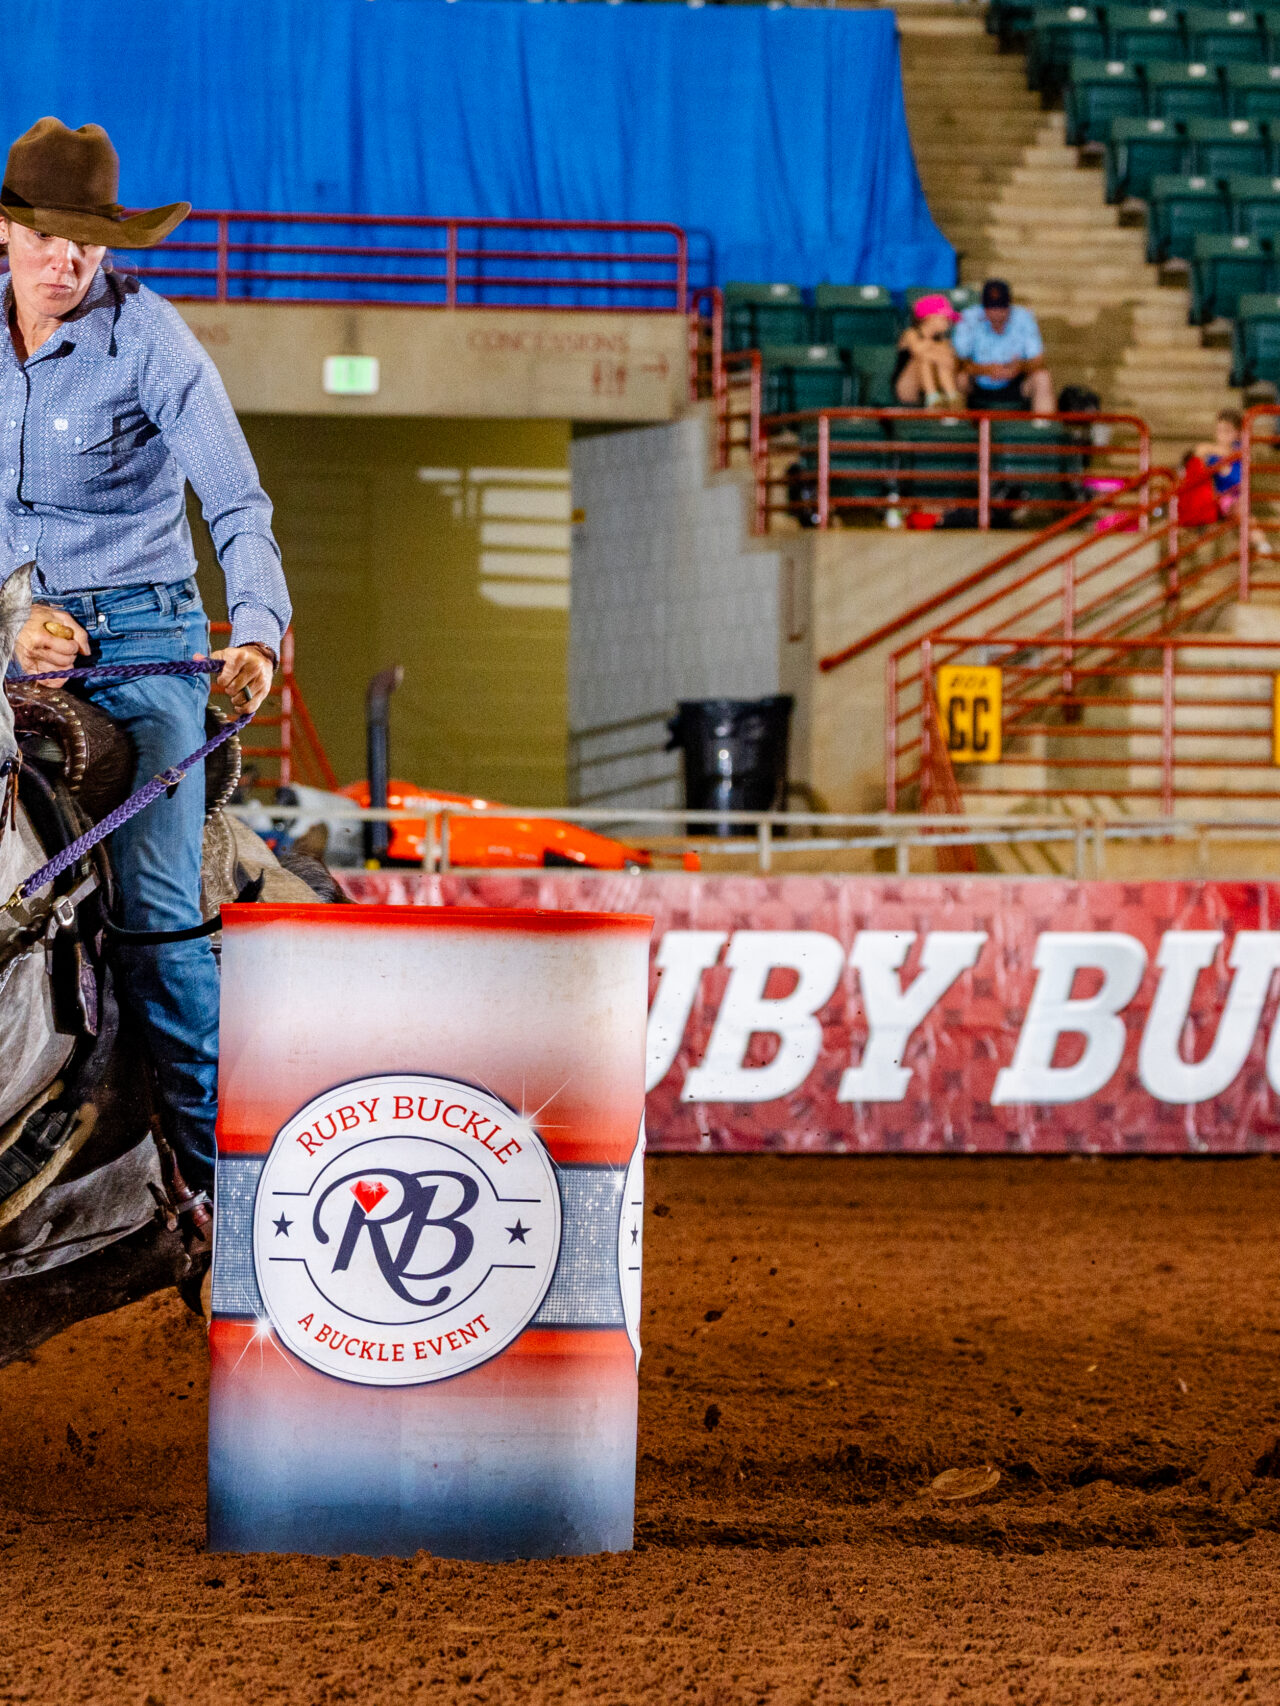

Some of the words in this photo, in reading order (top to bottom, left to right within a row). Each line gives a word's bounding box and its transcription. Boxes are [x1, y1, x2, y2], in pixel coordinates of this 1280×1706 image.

[644, 930, 989, 1102] BY
[991, 930, 1280, 1107] BU
[296, 1097, 381, 1158] RUBY
[392, 1095, 523, 1165] BUCKLE
[312, 1167, 480, 1307] RB
[297, 1313, 314, 1332] A
[314, 1323, 406, 1362] BUCKLE
[414, 1313, 492, 1360] EVENT
